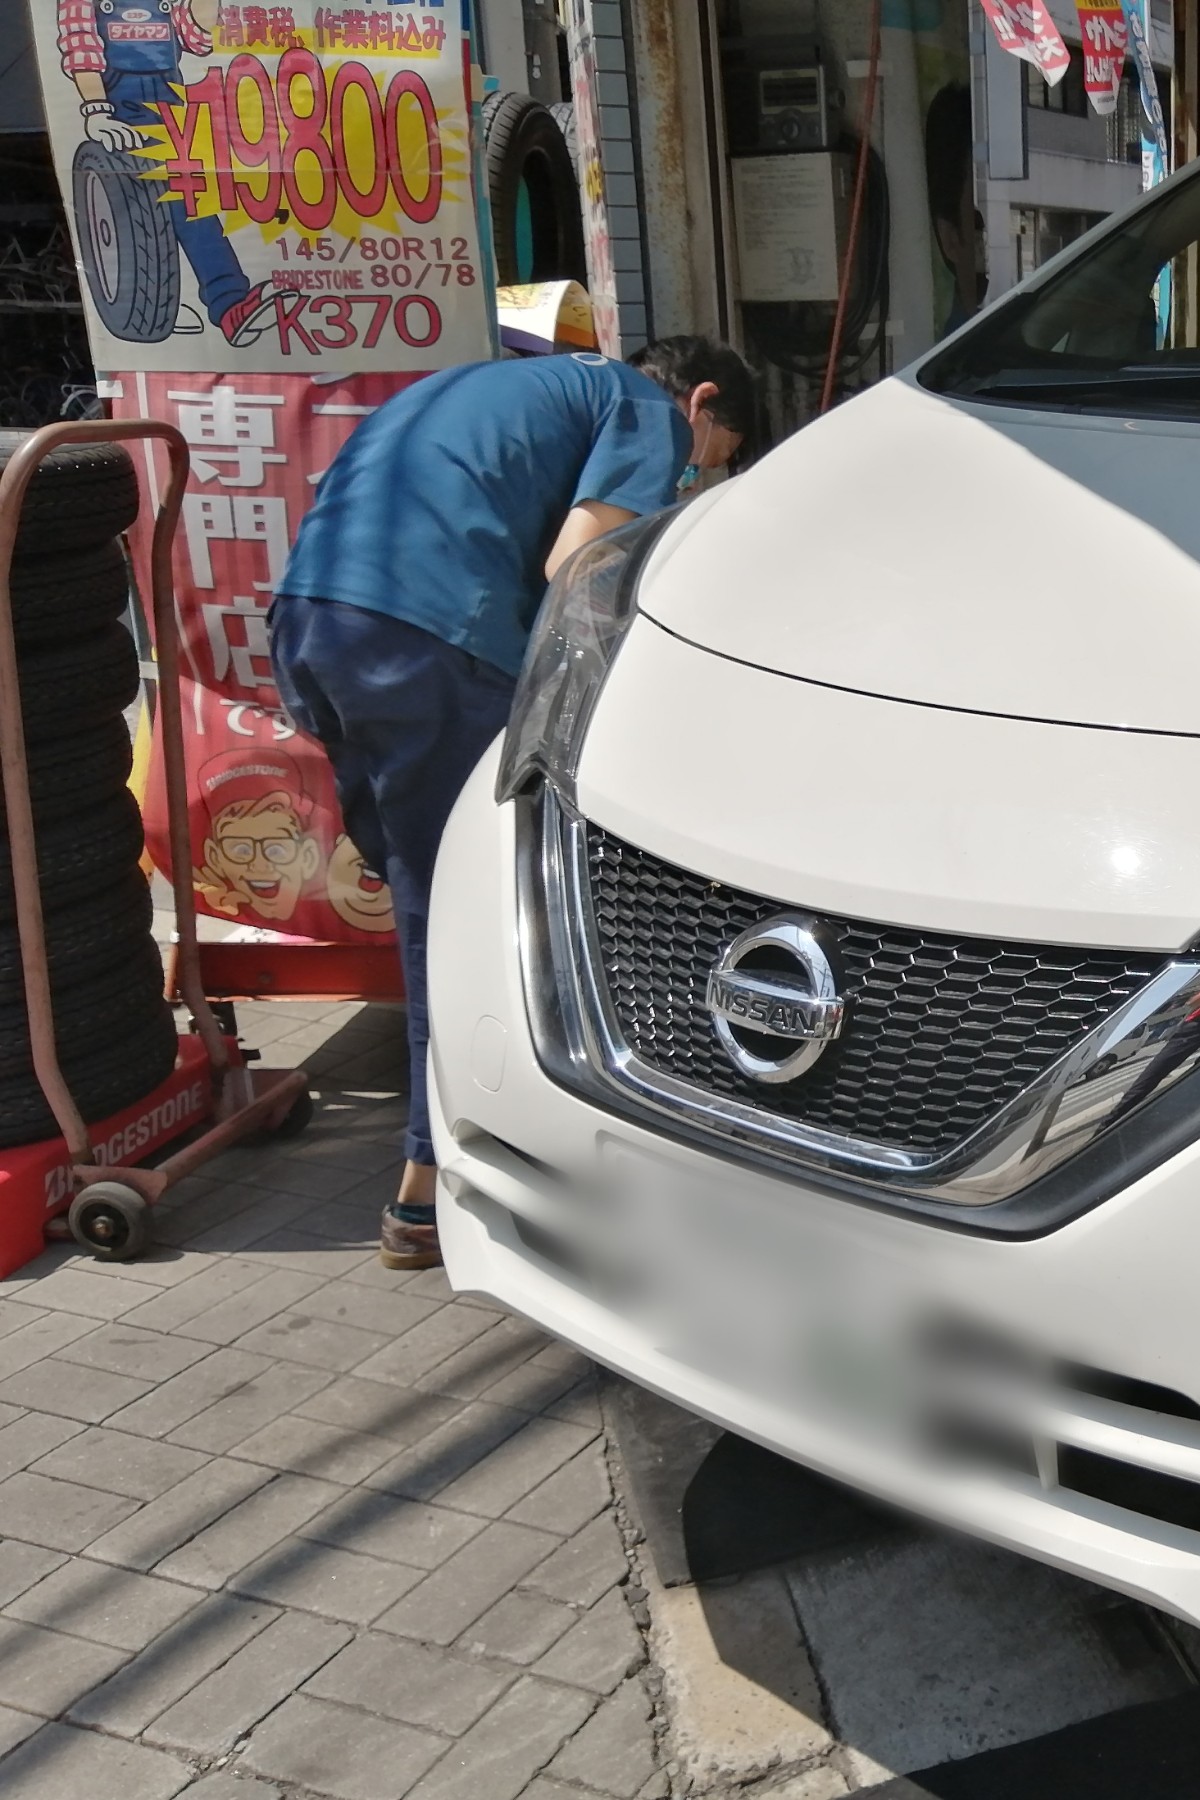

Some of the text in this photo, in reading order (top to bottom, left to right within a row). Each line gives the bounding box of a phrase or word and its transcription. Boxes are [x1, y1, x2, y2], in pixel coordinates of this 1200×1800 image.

[111, 25, 168, 39] タイヤマン
[217, 5, 447, 51] 消費税、作業料込み
[370, 262, 475, 289] 80/78
[273, 294, 442, 355] K370
[709, 978, 816, 1033] NISSAN
[45, 1081, 202, 1208] BDGESTONE
